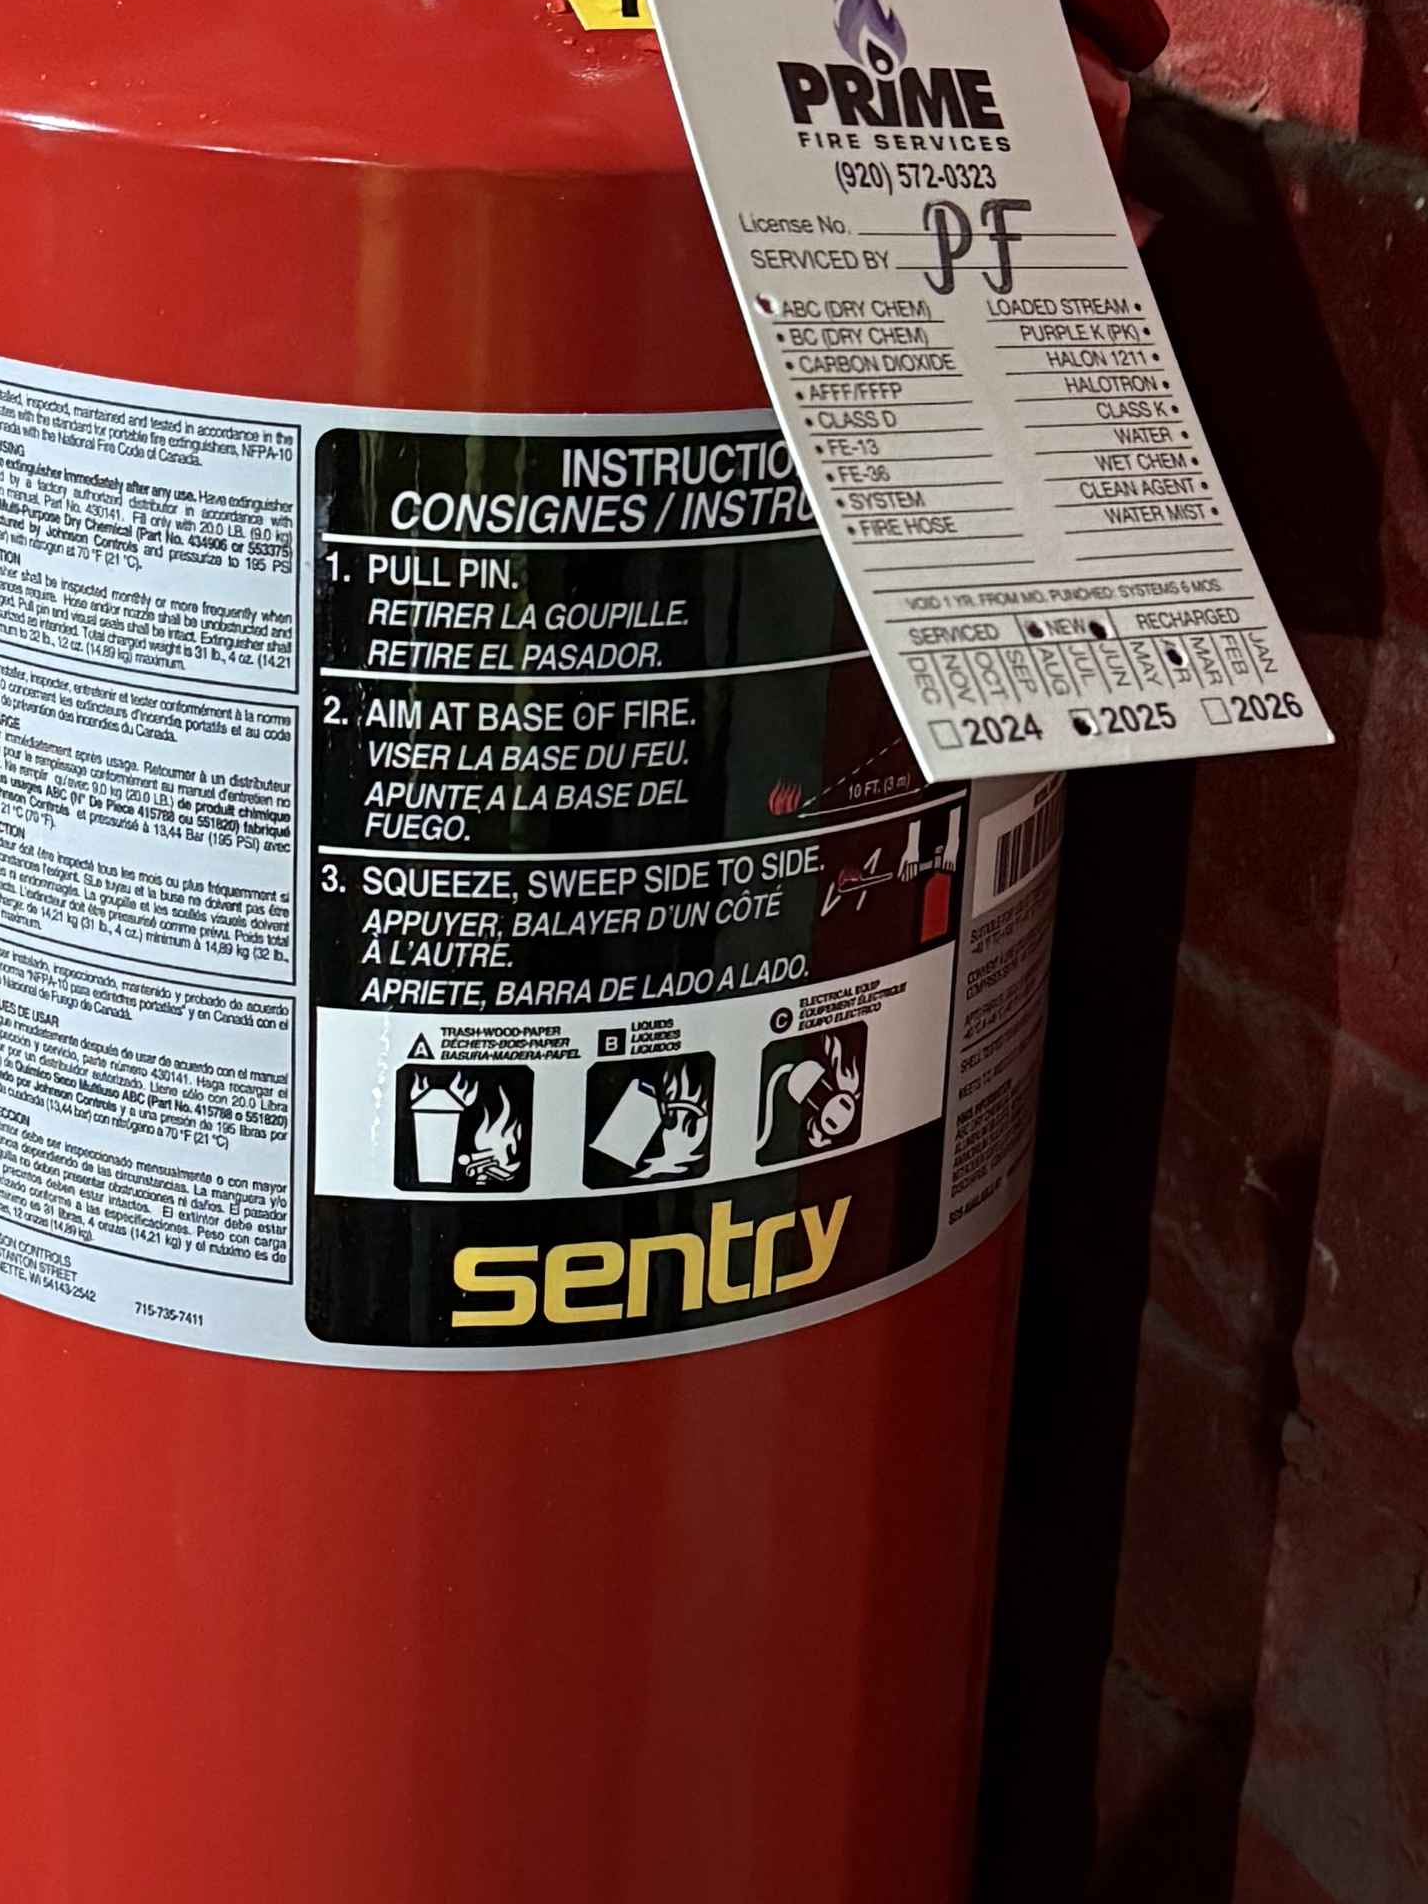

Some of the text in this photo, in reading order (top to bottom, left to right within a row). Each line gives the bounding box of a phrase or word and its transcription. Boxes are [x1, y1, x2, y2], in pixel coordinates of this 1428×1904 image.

[798, 131, 1011, 153] FIRE SERVICES
[835, 162, 996, 195] (920) 572-0323
[740, 214, 852, 235] License No.
[750, 249, 892, 271] SERVICED BY
[782, 300, 931, 320] ABC (DRY CHEM)
[987, 298, 1130, 318] LOADED STREAM
[789, 327, 929, 349] BC (DRY CHEM)
[1020, 322, 1140, 344] PURPLE K (PK)
[799, 353, 956, 373] CARBON DIOXIDE
[1045, 349, 1148, 369] HALON 1211
[810, 382, 902, 401] AFFF/FFFP
[1066, 375, 1158, 395] HALOTRON
[818, 410, 896, 428] CLASS D
[1096, 400, 1168, 420] CLASS K
[827, 439, 879, 456] FE-13
[1113, 427, 1172, 446] WATER
[562, 441, 796, 488] INSTRUCTIO
[1095, 452, 1188, 472] WET CHEM
[850, 492, 926, 510] SYSTEM
[1079, 478, 1196, 500] CLEAN AGENT
[390, 491, 647, 533] CONSIGNES
[859, 517, 957, 536] FIRE HOSE
[1104, 504, 1205, 525] WATER MIST
[325, 553, 518, 589] 1. PULL PIN.
[368, 599, 690, 630] RETIRER LA GOUPILLE.
[1048, 618, 1086, 635] NEW
[1136, 608, 1240, 629] RECHARGED
[909, 623, 999, 646] SERVICED
[368, 641, 663, 671] RETIRE EL PASADOR.
[1069, 645, 1096, 678] JUL
[1099, 643, 1130, 687] JUN
[1131, 641, 1163, 686] MAY
[1190, 637, 1223, 685] MAR
[1220, 634, 1248, 675] FEB
[1248, 632, 1277, 674] JAN
[908, 657, 941, 705] DEC
[942, 654, 976, 703] NOV
[974, 651, 1008, 699] OCT
[1005, 650, 1037, 694] SEP
[1037, 648, 1070, 696] AUG
[322, 697, 696, 731] 2. AIM AT BASE OF FIRE.
[967, 691, 1304, 746] 2024 2025 2026
[368, 741, 690, 771] VISER LA BASE DU FEU.
[486, 785, 505, 810] A
[512, 785, 548, 811] LA
[555, 783, 632, 810] BASE
[637, 779, 687, 806] DEL
[365, 812, 471, 842] FUEGO.
[321, 846, 826, 905] 3. SQUEEZE, SWEEP SIDE TO SIDE.
[362, 886, 782, 940] APPUYER, BALAYER D'UN CÔTÉ
[362, 932, 513, 967] À L'AUTRE.
[361, 954, 809, 1011] APRIETE, BARRA DE LADO A LADO.
[632, 1019, 674, 1031] LIQUIDS
[451, 1196, 852, 1329] sentry
[135, 1301, 204, 1326] 715-735-7411
